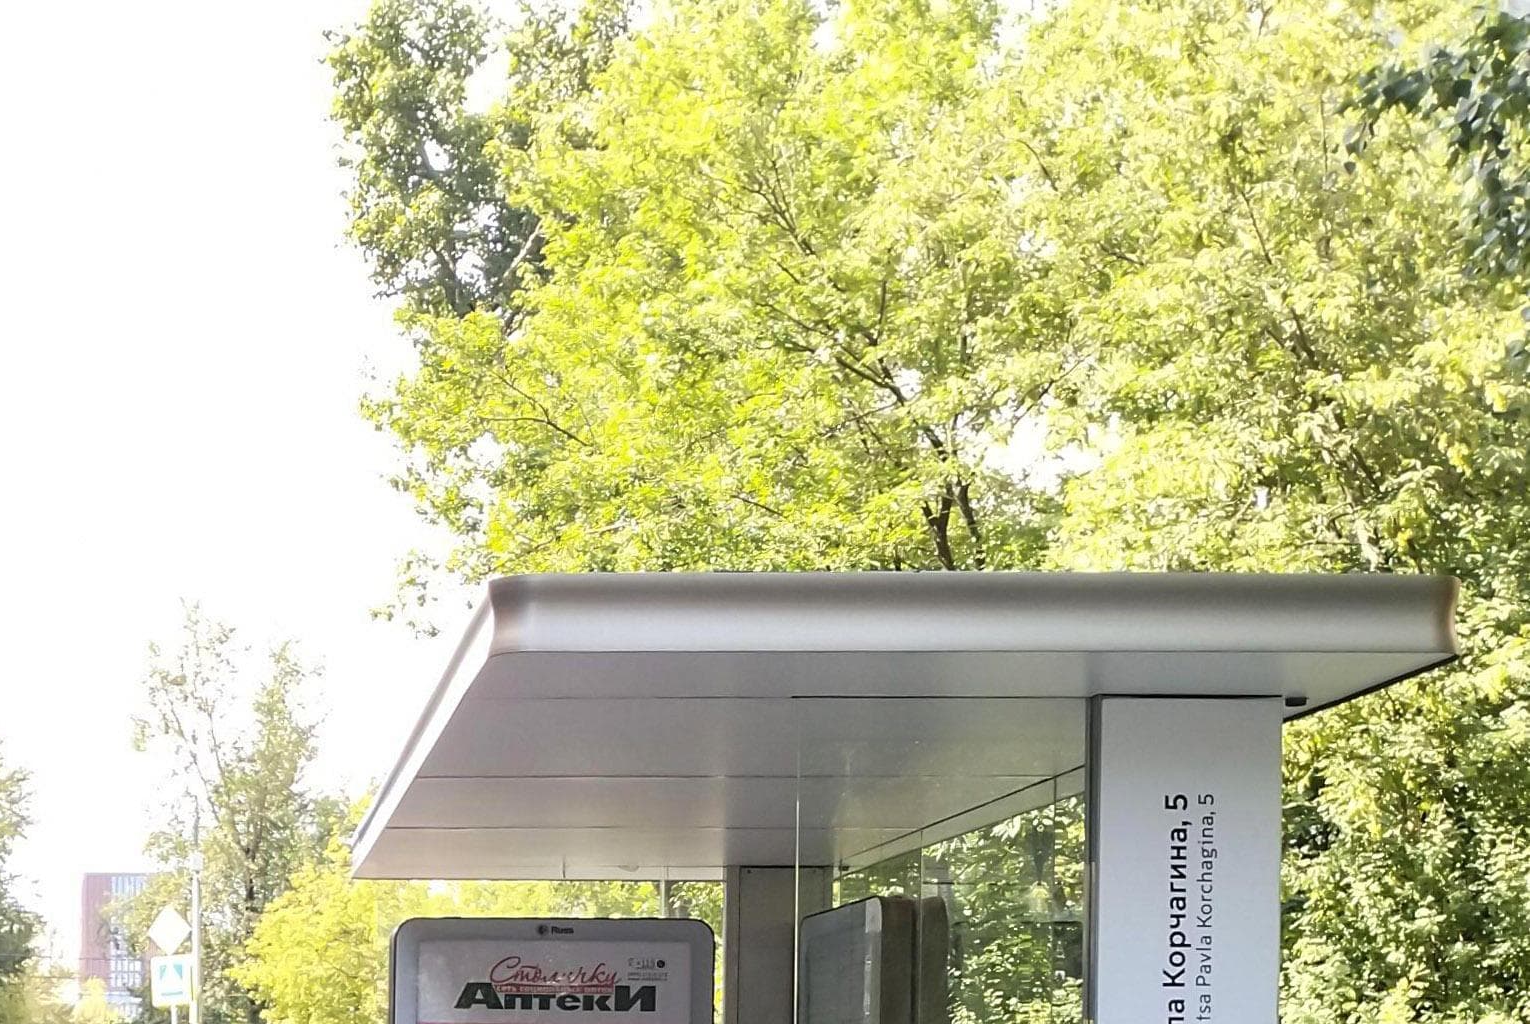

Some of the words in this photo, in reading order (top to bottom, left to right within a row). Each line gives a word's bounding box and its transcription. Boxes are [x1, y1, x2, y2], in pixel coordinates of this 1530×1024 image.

[1164, 794, 1189, 811] 5
[1197, 793, 1214, 805] 5
[1196, 811, 1217, 927] Korchagina,
[1162, 821, 1193, 988] Корчагина,
[1195, 936, 1213, 987] Pavla
